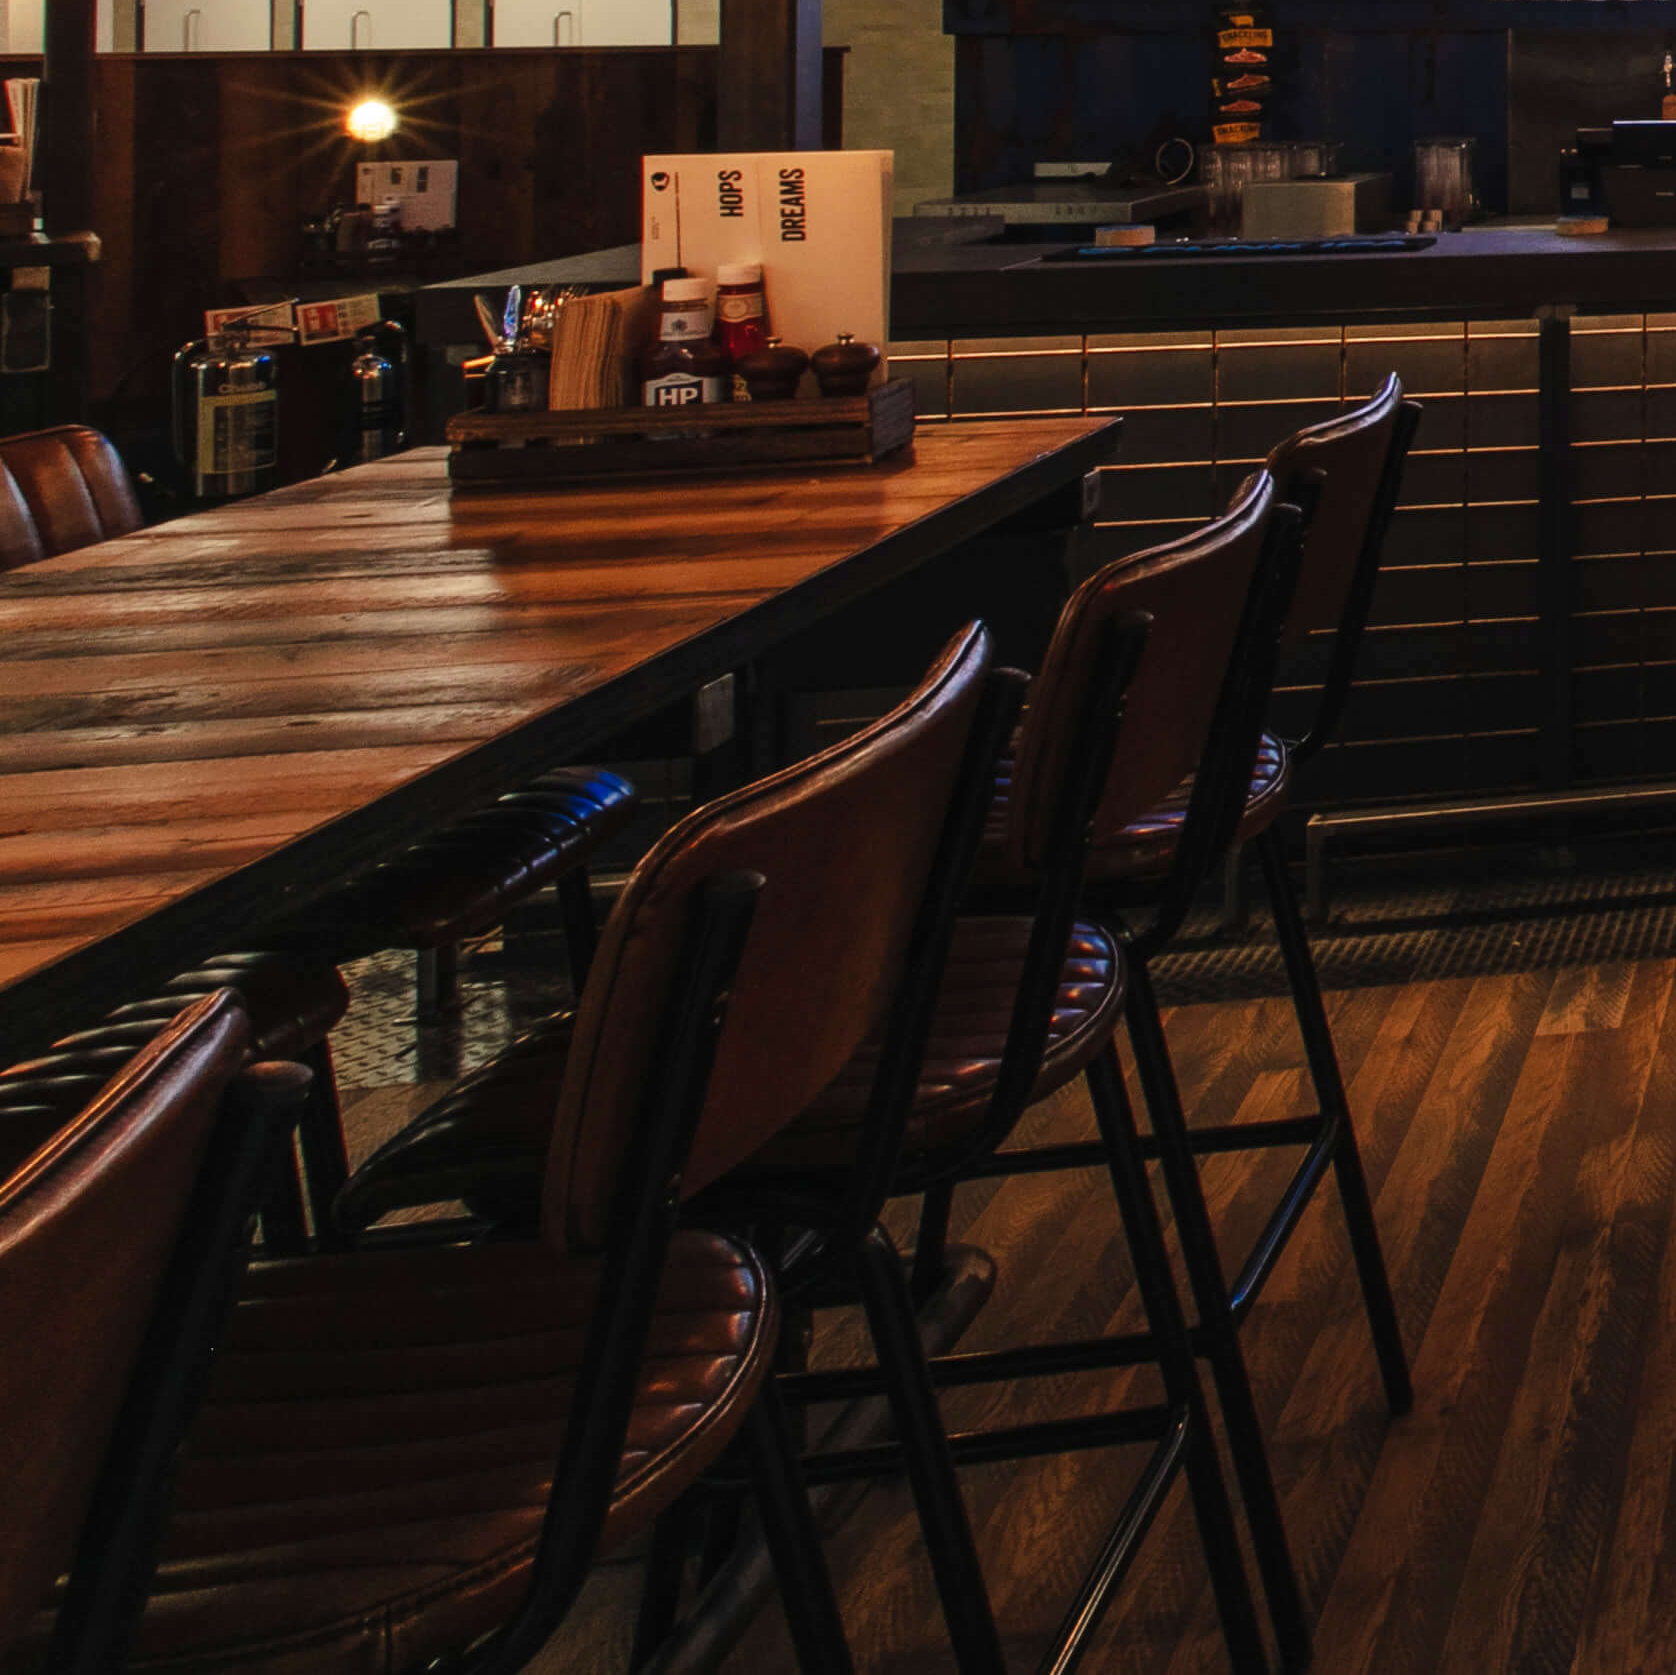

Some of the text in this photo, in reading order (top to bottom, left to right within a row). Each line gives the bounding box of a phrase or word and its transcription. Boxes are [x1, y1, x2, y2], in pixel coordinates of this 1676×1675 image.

[717, 169, 745, 218] HOPS
[778, 168, 807, 242] DREAMS
[658, 387, 699, 405] HP
